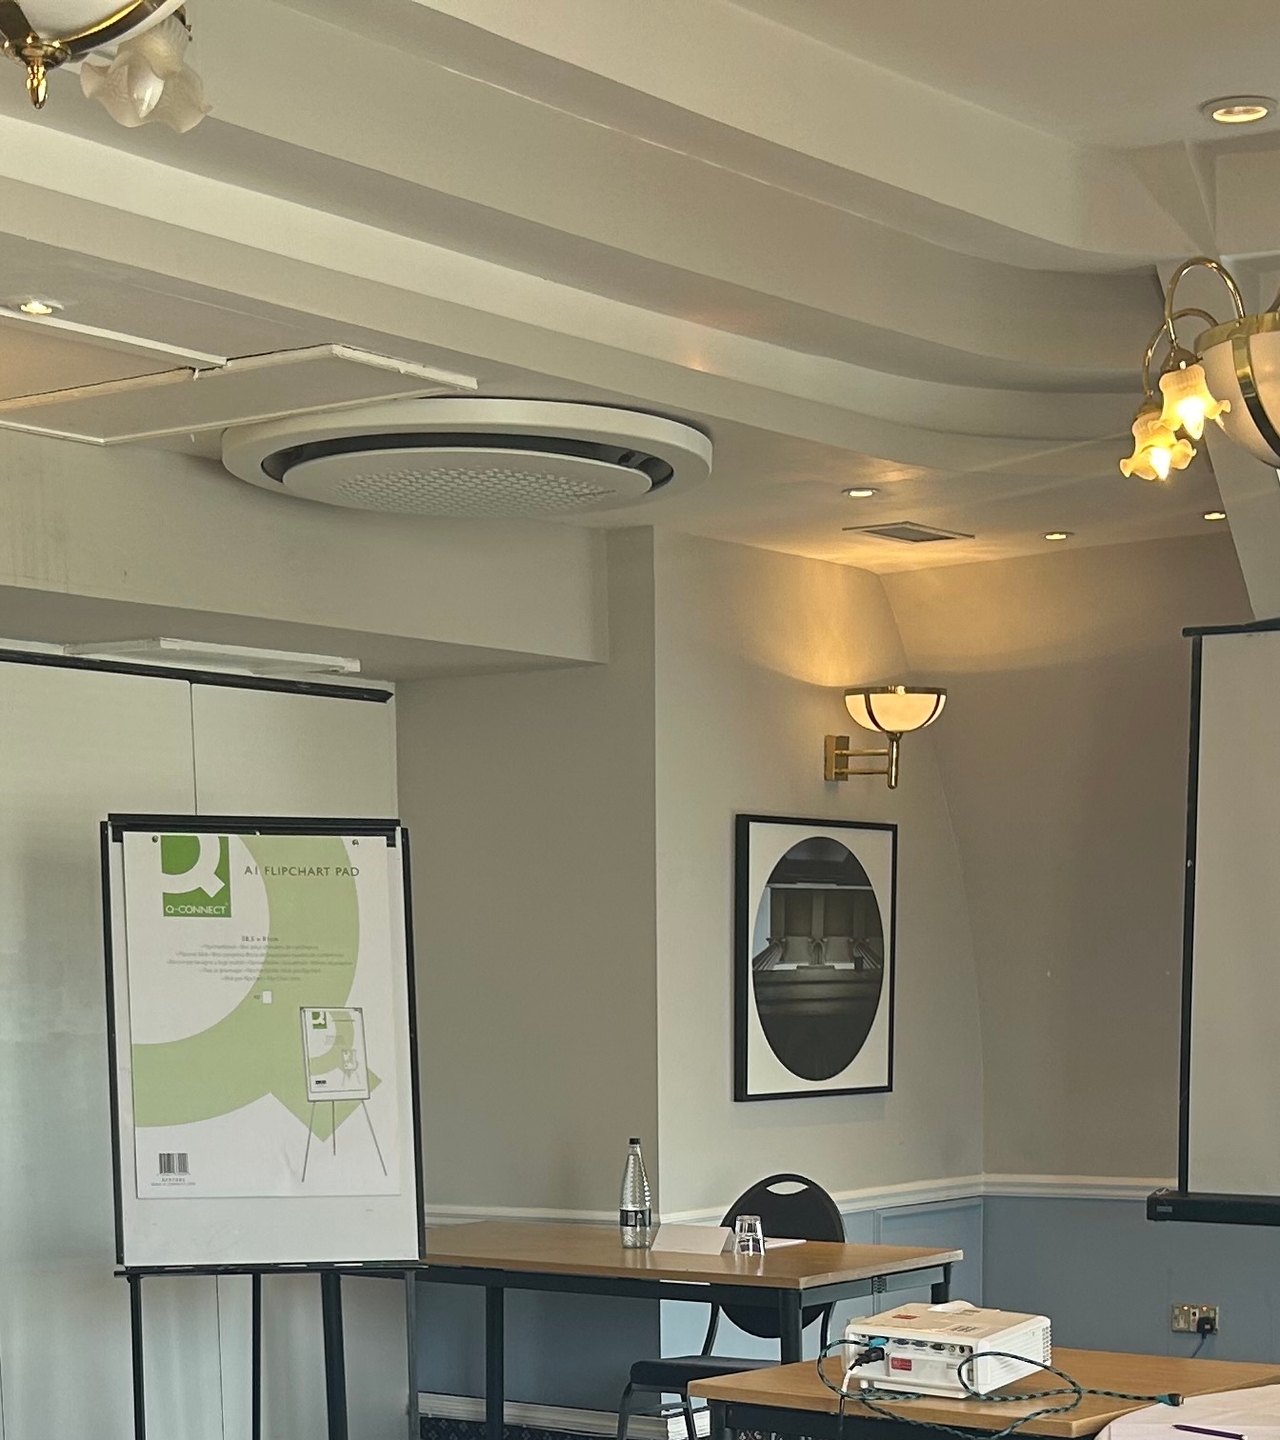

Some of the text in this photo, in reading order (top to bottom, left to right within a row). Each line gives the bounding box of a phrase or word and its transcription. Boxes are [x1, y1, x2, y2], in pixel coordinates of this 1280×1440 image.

[264, 866, 331, 877] FLIPCHART
[335, 867, 360, 877] PAD
[165, 904, 227, 915] Q-CONNECT
